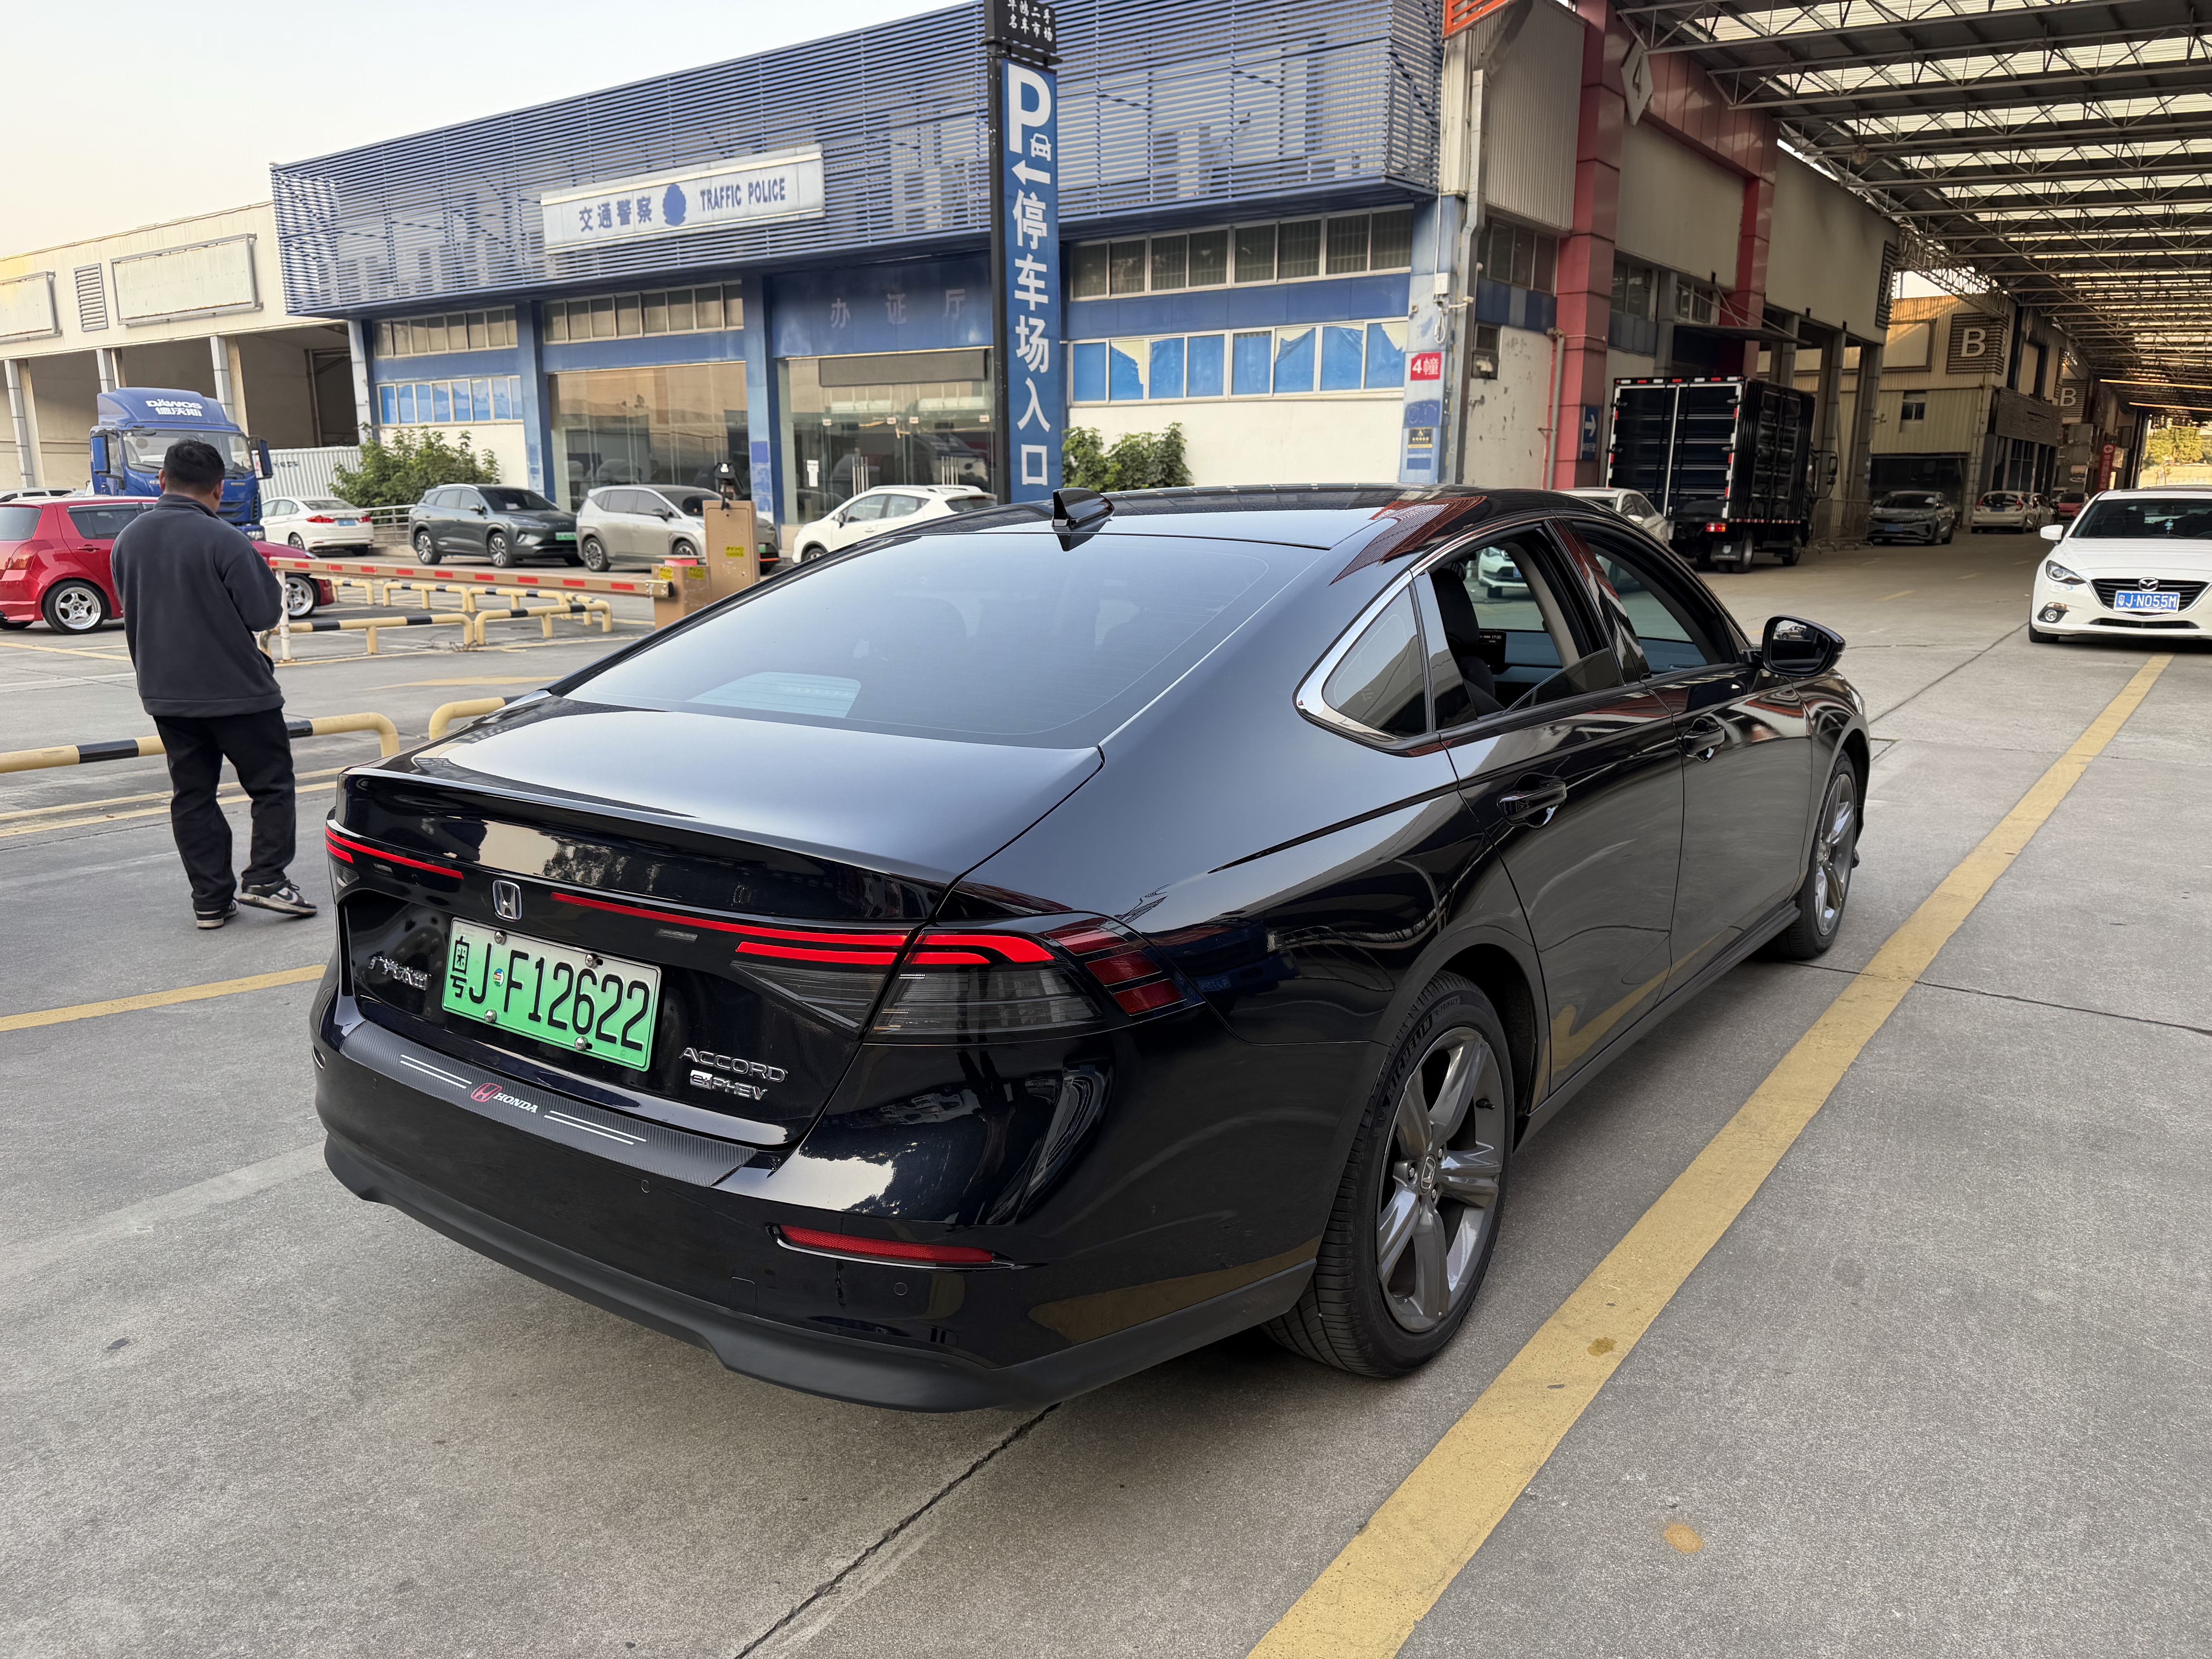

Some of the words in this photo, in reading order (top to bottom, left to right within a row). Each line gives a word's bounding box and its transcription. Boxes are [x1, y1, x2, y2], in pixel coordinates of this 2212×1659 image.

[1008, 14, 1053, 42] 名车市场
[1008, 63, 1051, 154] P
[579, 196, 652, 232] 交通警察
[700, 184, 742, 211] TRAFFIC
[749, 177, 786, 203] POLICE
[830, 289, 966, 329] 办证厅
[1012, 190, 1051, 486] 停车场入口
[1961, 328, 1986, 358] B
[1412, 357, 1439, 376] 4幢
[2060, 387, 2076, 407] B
[678, 1047, 788, 1083] ACCORD
[1386, 1012, 1434, 1102] MICHELIN
[493, 1092, 538, 1113] HONDA
